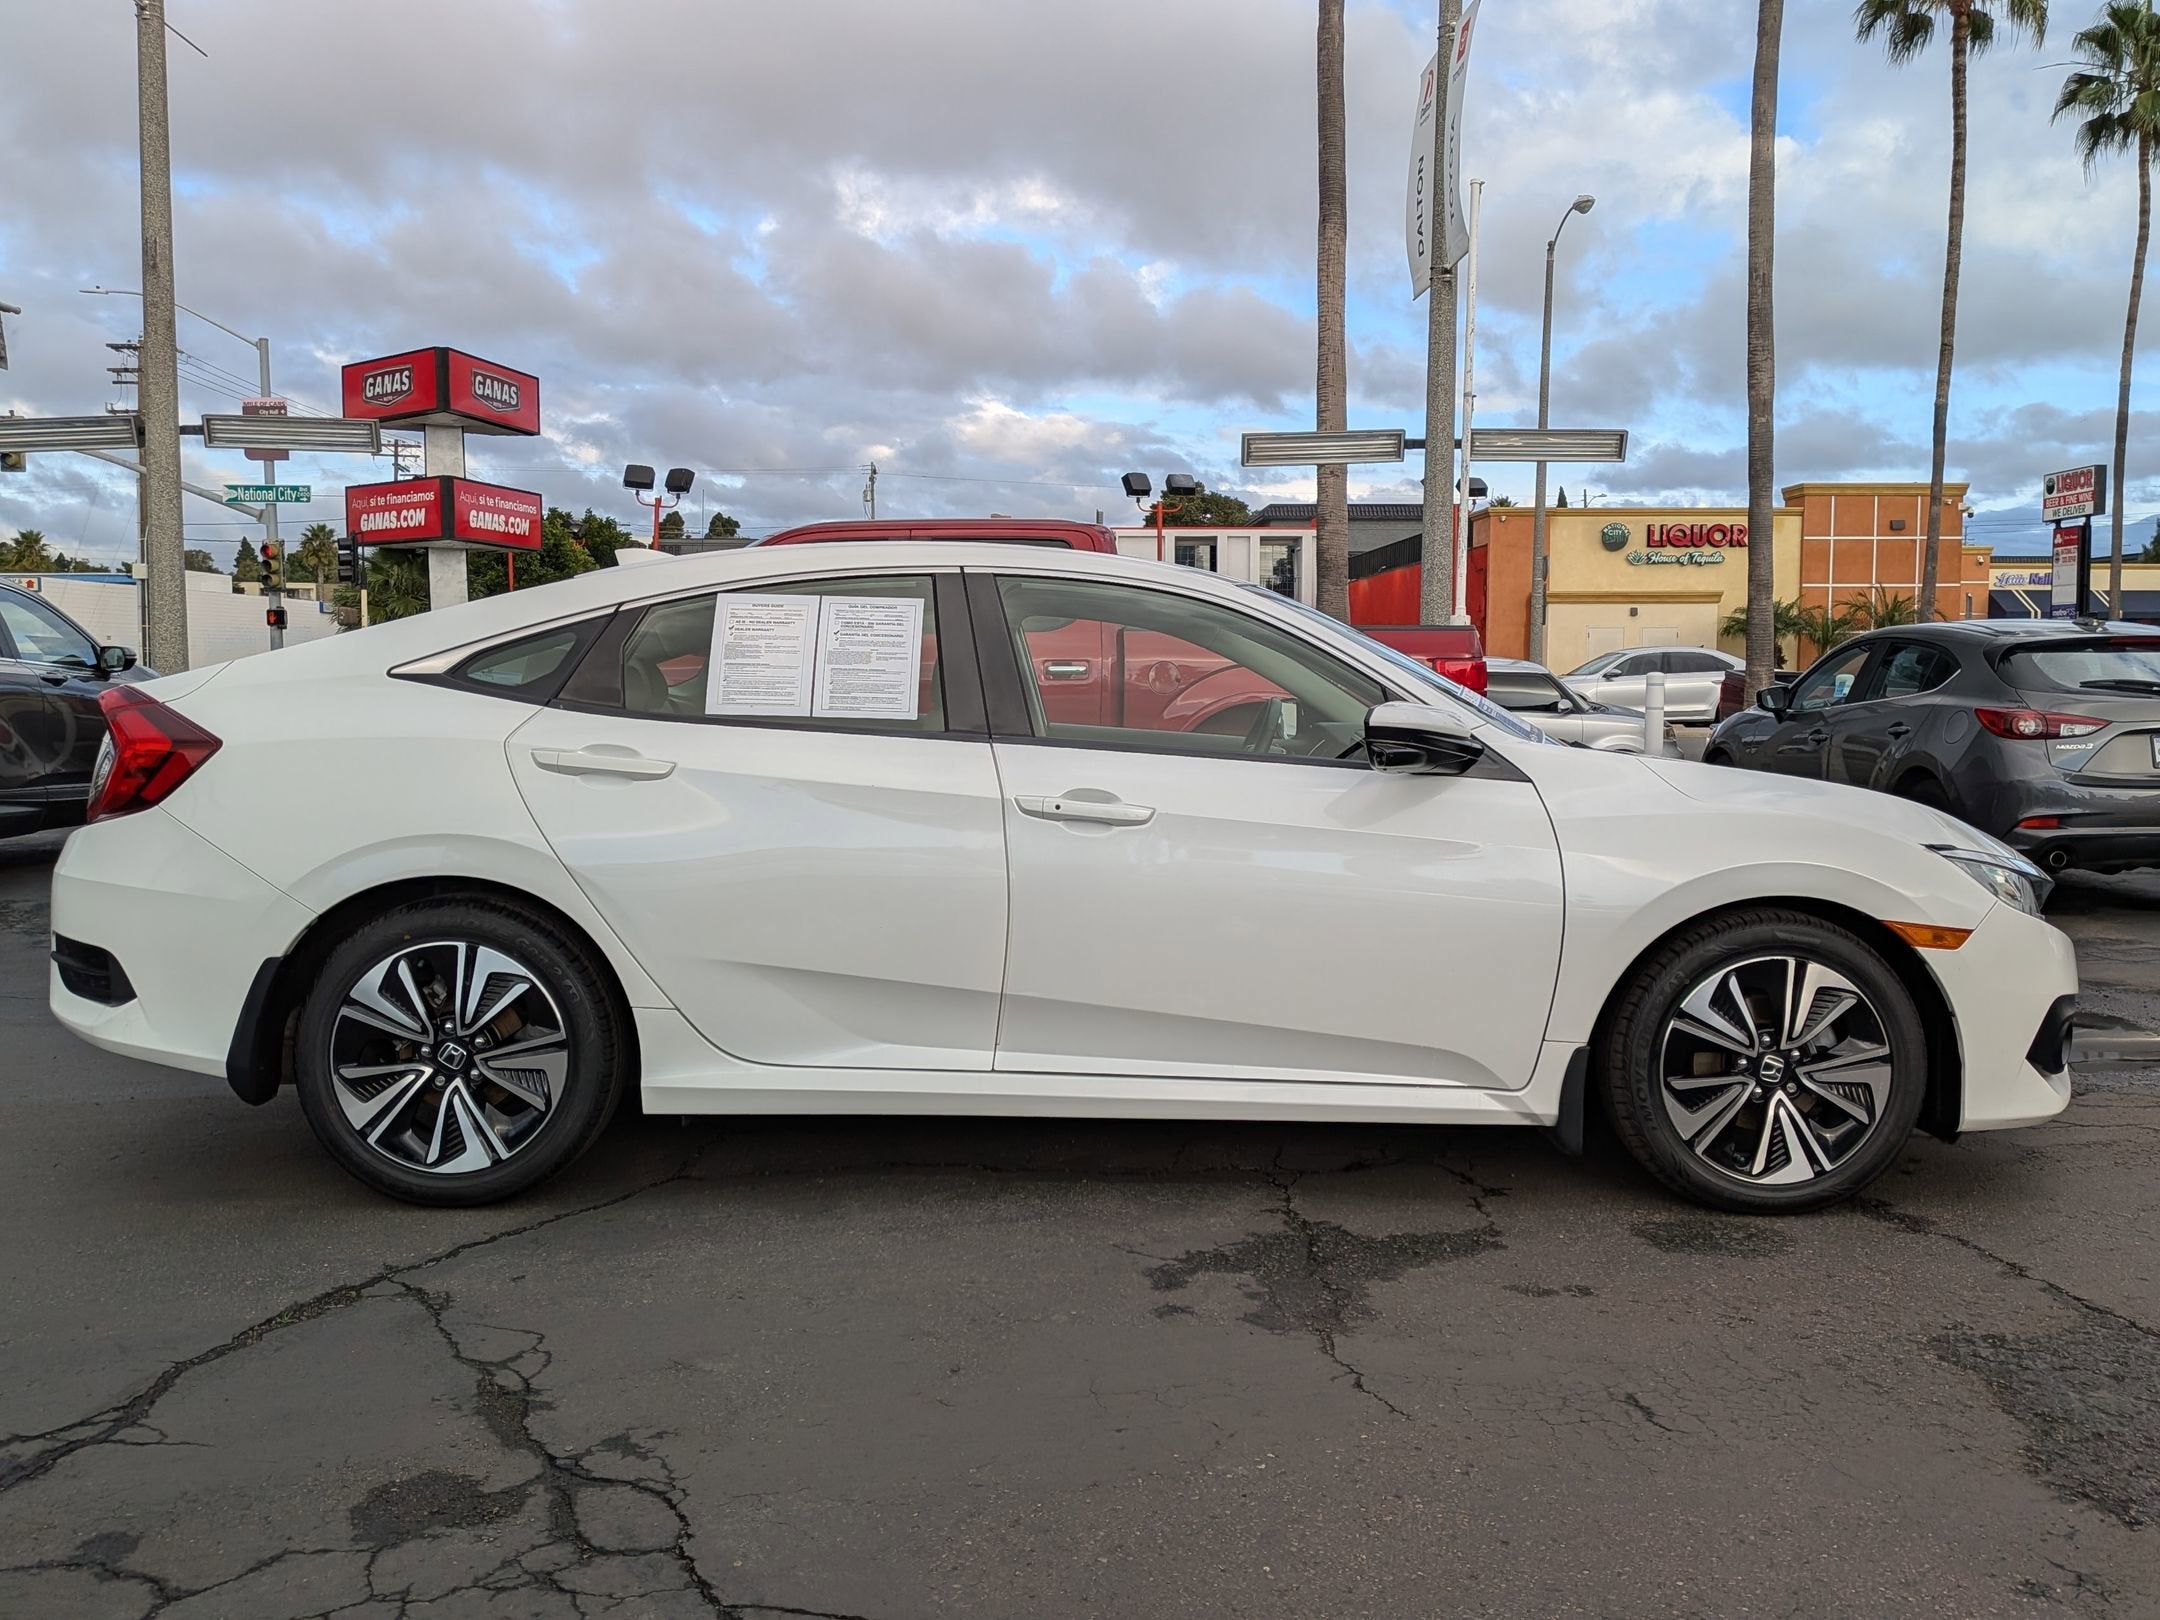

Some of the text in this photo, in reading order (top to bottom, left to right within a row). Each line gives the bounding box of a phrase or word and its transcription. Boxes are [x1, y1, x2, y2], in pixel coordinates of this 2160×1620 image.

[1448, 113, 1456, 226] TOYOTA
[1416, 154, 1425, 258] DALTON
[365, 370, 410, 398] GANAS
[475, 375, 518, 405] GANAS
[2056, 468, 2093, 494] LIQUOR
[237, 487, 298, 502] National City
[377, 496, 385, 506] te
[387, 491, 435, 505] financiamos
[486, 496, 494, 506] te
[495, 497, 537, 515] financiamos
[2045, 490, 2093, 508] BEER & FINE WINE
[360, 507, 426, 532] GANAS.COM
[469, 509, 530, 536] GANAS.COM
[2052, 504, 2086, 518] WE DELIVER
[1603, 522, 1630, 537] NATIONAL
[1647, 523, 1748, 548] LIQUOR
[1648, 551, 1724, 566] House of Tequila
